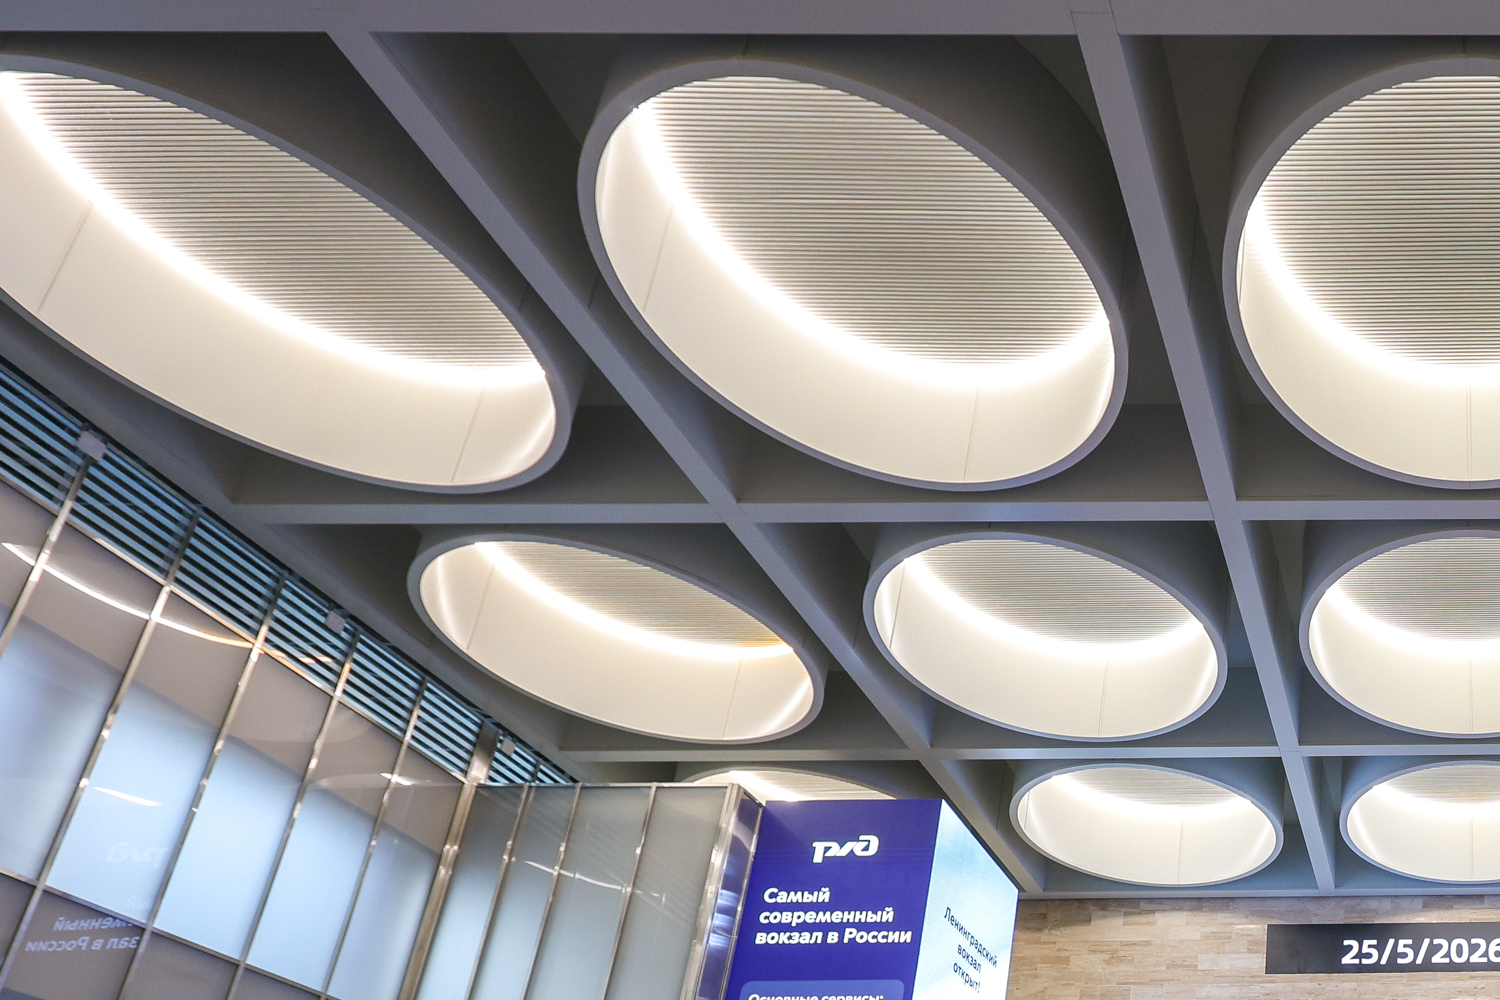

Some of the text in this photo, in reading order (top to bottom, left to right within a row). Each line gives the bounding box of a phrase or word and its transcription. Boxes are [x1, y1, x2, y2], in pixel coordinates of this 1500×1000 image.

[764, 888, 830, 903] Самый
[760, 907, 894, 926] современный
[755, 928, 912, 944] вокзал в России
[943, 905, 998, 968] Ленинградский
[957, 944, 981, 972] вокзал
[952, 961, 981, 994] открыт!
